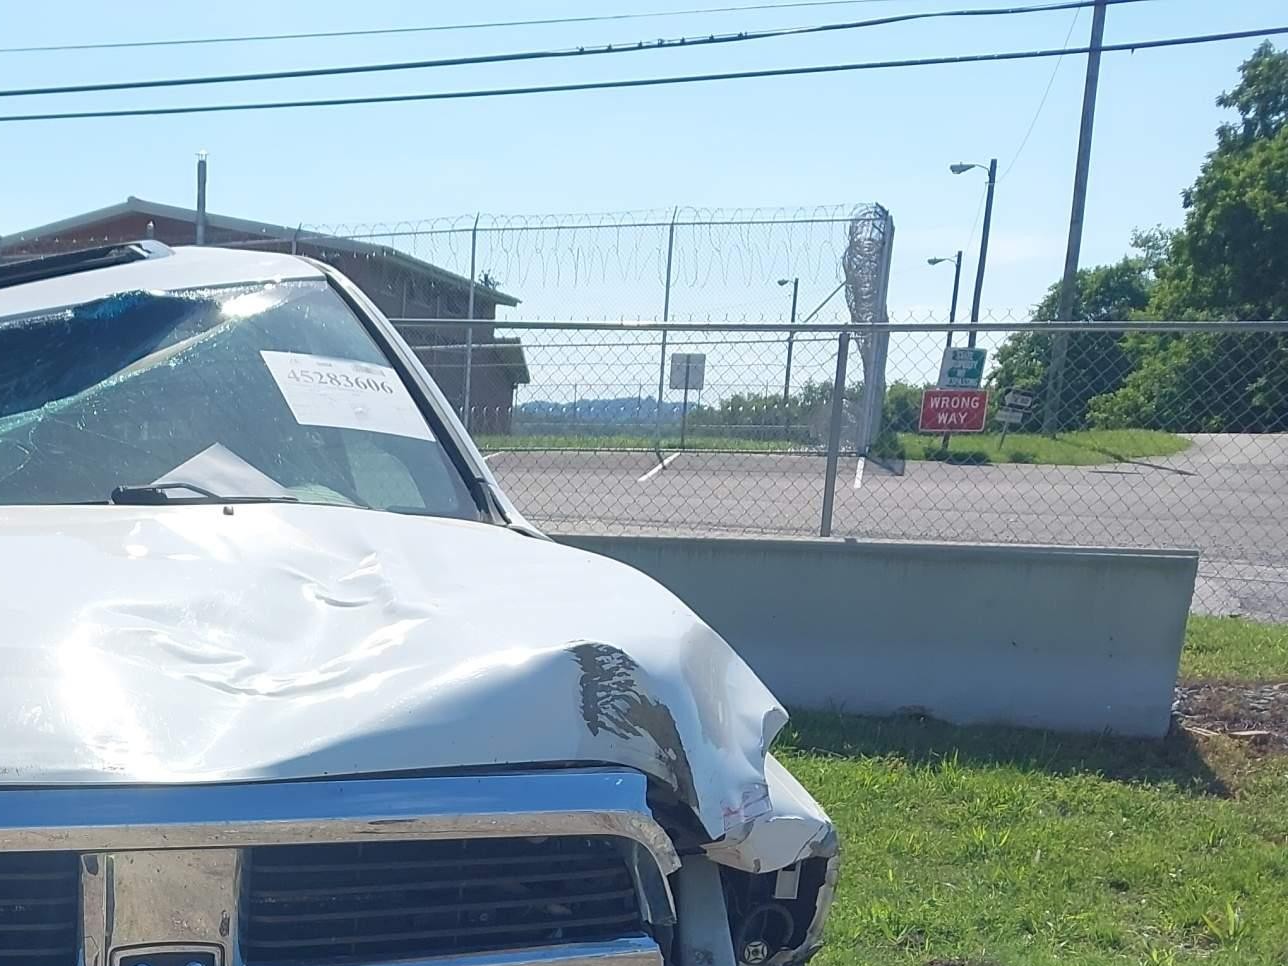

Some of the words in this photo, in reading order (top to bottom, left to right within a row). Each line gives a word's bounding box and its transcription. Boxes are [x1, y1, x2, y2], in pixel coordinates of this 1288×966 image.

[287, 369, 394, 395] 45283606
[930, 396, 980, 410] WRONG
[937, 412, 969, 425] WAY
